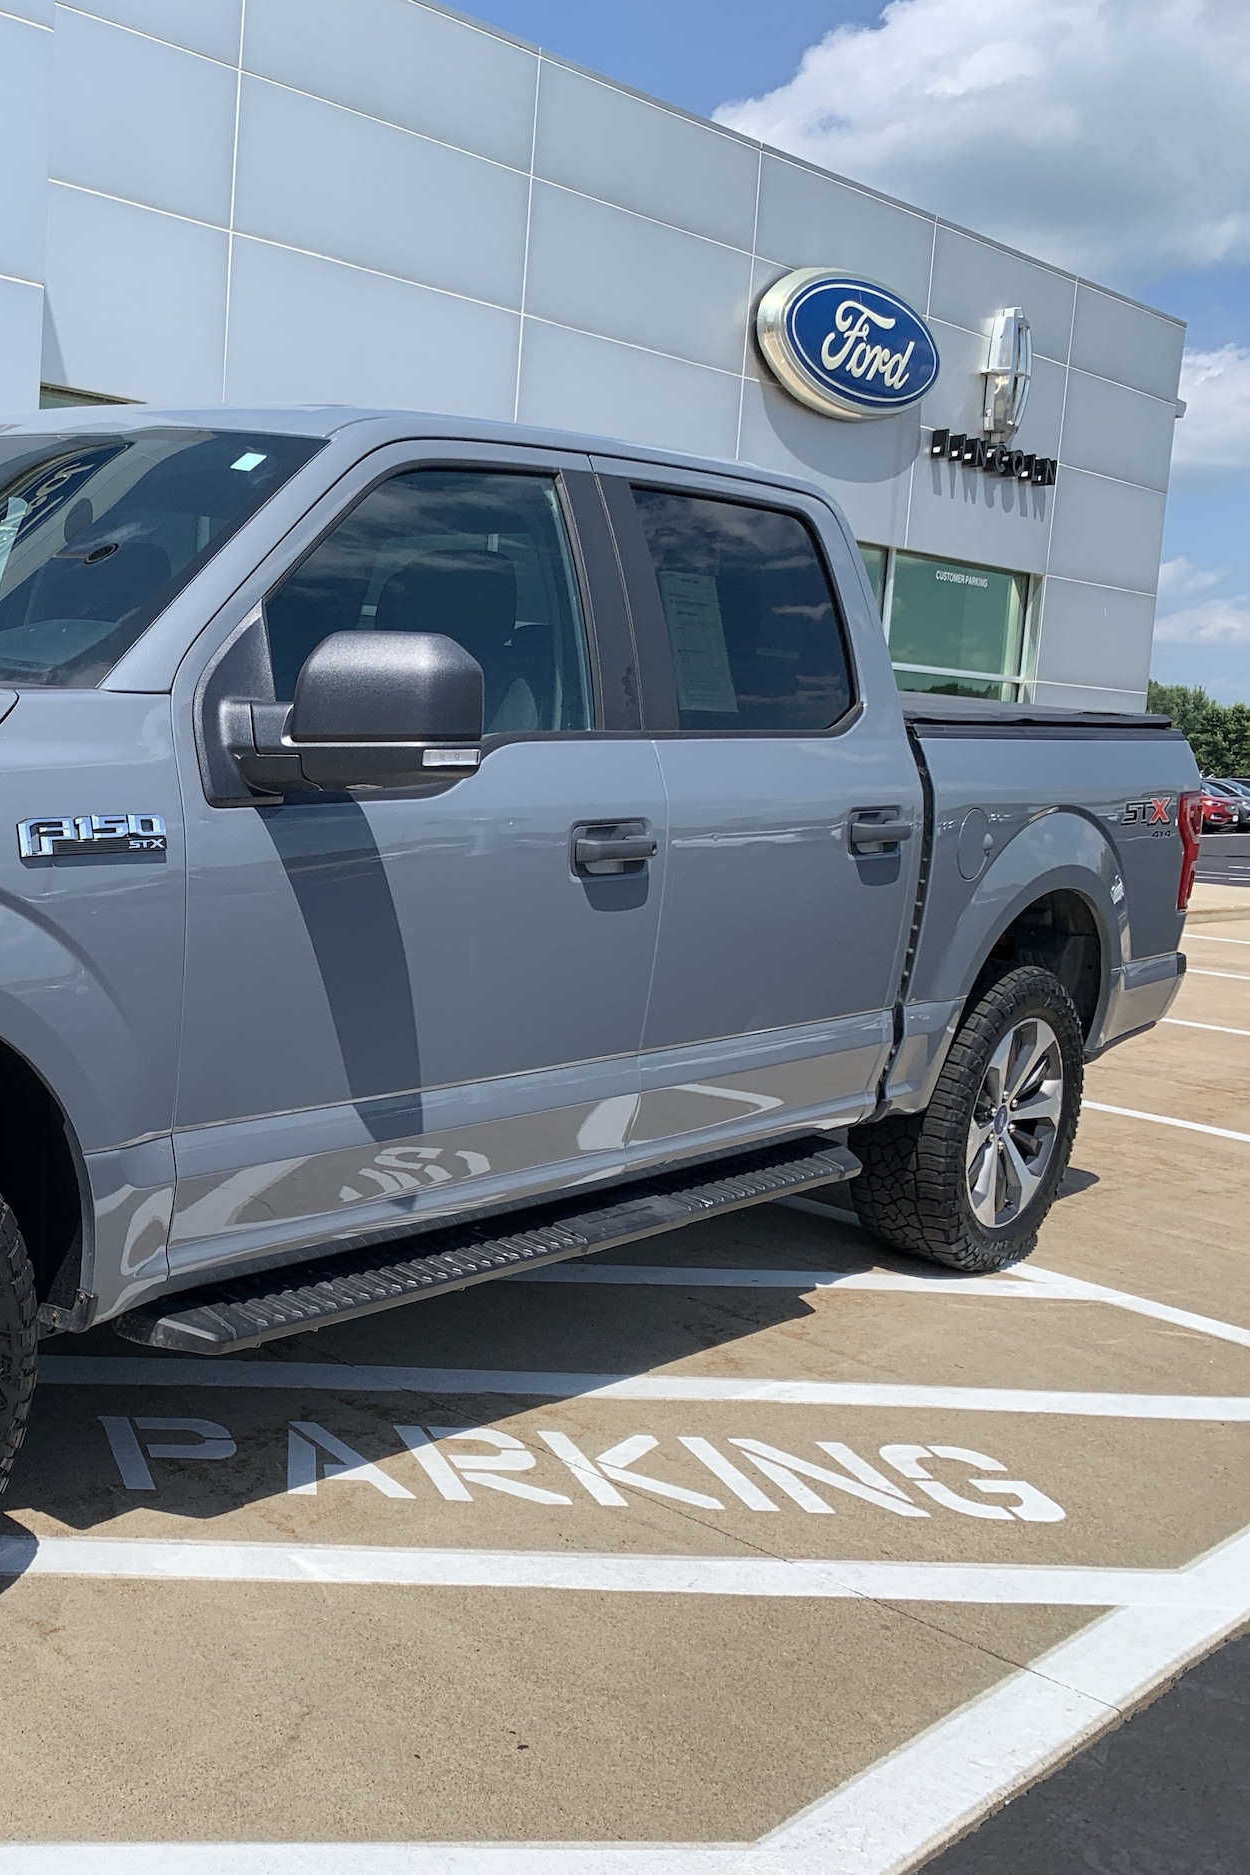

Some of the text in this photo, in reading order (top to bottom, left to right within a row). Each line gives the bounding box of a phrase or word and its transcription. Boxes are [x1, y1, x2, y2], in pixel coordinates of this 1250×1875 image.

[821, 300, 915, 390] Ford
[935, 570, 988, 588] CUSTOMER PARKING
[1121, 797, 1171, 826] STX
[128, 838, 165, 850] STX
[97, 1414, 1066, 1523] PARKING
